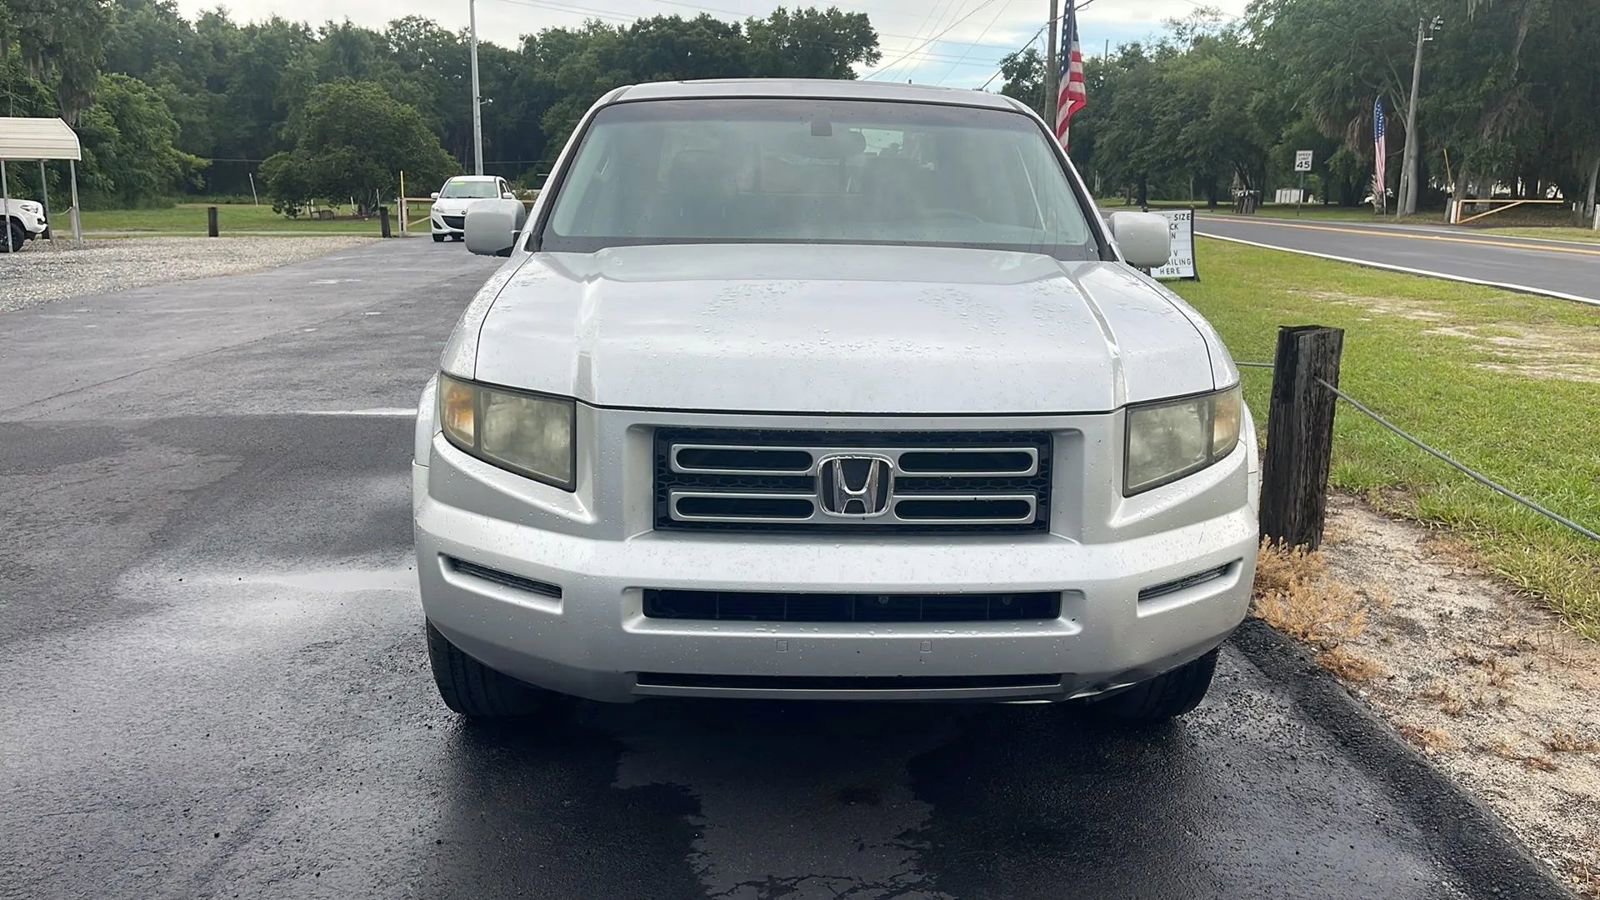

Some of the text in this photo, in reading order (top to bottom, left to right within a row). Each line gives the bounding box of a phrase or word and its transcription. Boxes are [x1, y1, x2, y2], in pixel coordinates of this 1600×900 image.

[1296, 160, 1310, 169] 45
[1174, 213, 1191, 221] SIZE
[1167, 258, 1191, 266] AILING
[1159, 267, 1181, 275] HERE
